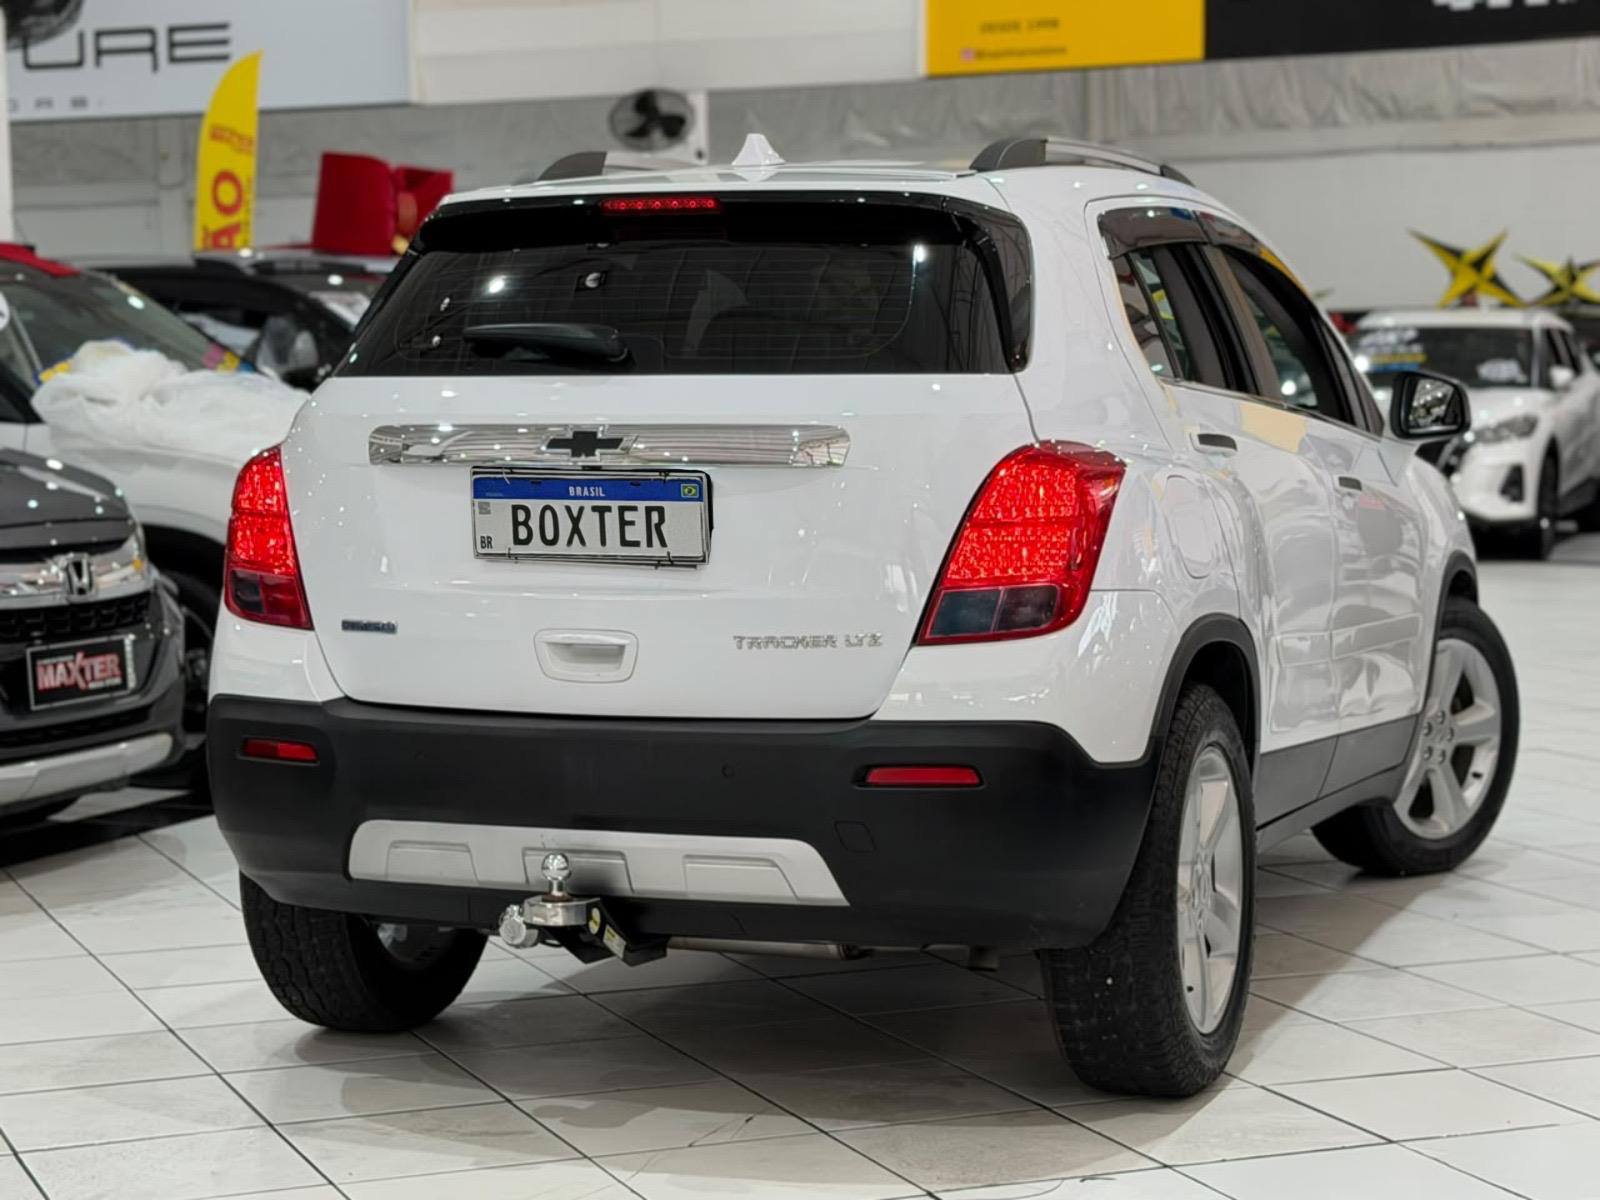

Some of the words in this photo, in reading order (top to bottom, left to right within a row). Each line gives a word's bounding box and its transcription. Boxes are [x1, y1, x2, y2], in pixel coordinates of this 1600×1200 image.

[568, 486, 606, 497] BRASIL
[511, 504, 668, 548] BOXTER
[480, 535, 493, 549] BR
[733, 635, 837, 650] TRACKER
[37, 651, 122, 690] MAXTER
